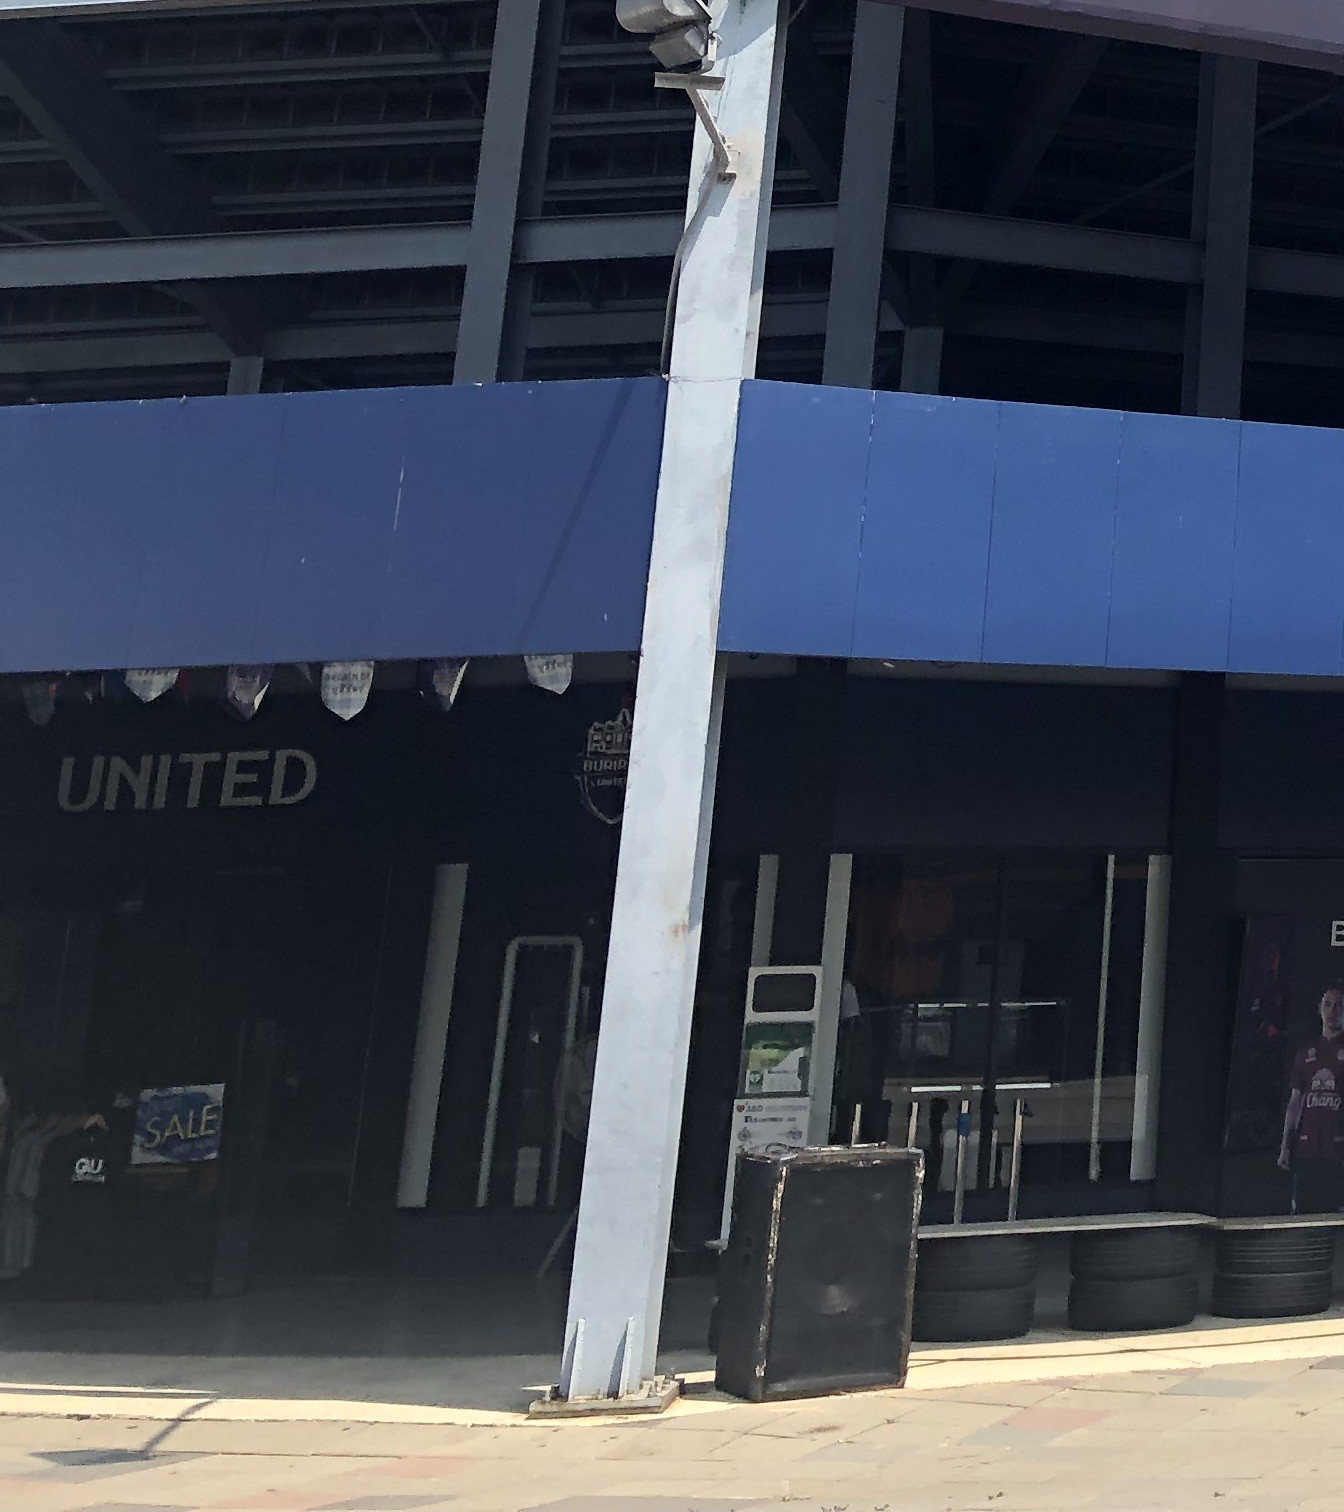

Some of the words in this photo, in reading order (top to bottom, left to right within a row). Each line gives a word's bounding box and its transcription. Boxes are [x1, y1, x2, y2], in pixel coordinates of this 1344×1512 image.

[57, 749, 318, 813] UNITED
[1306, 1090, 1342, 1111] Chang
[143, 1102, 218, 1149] SALE
